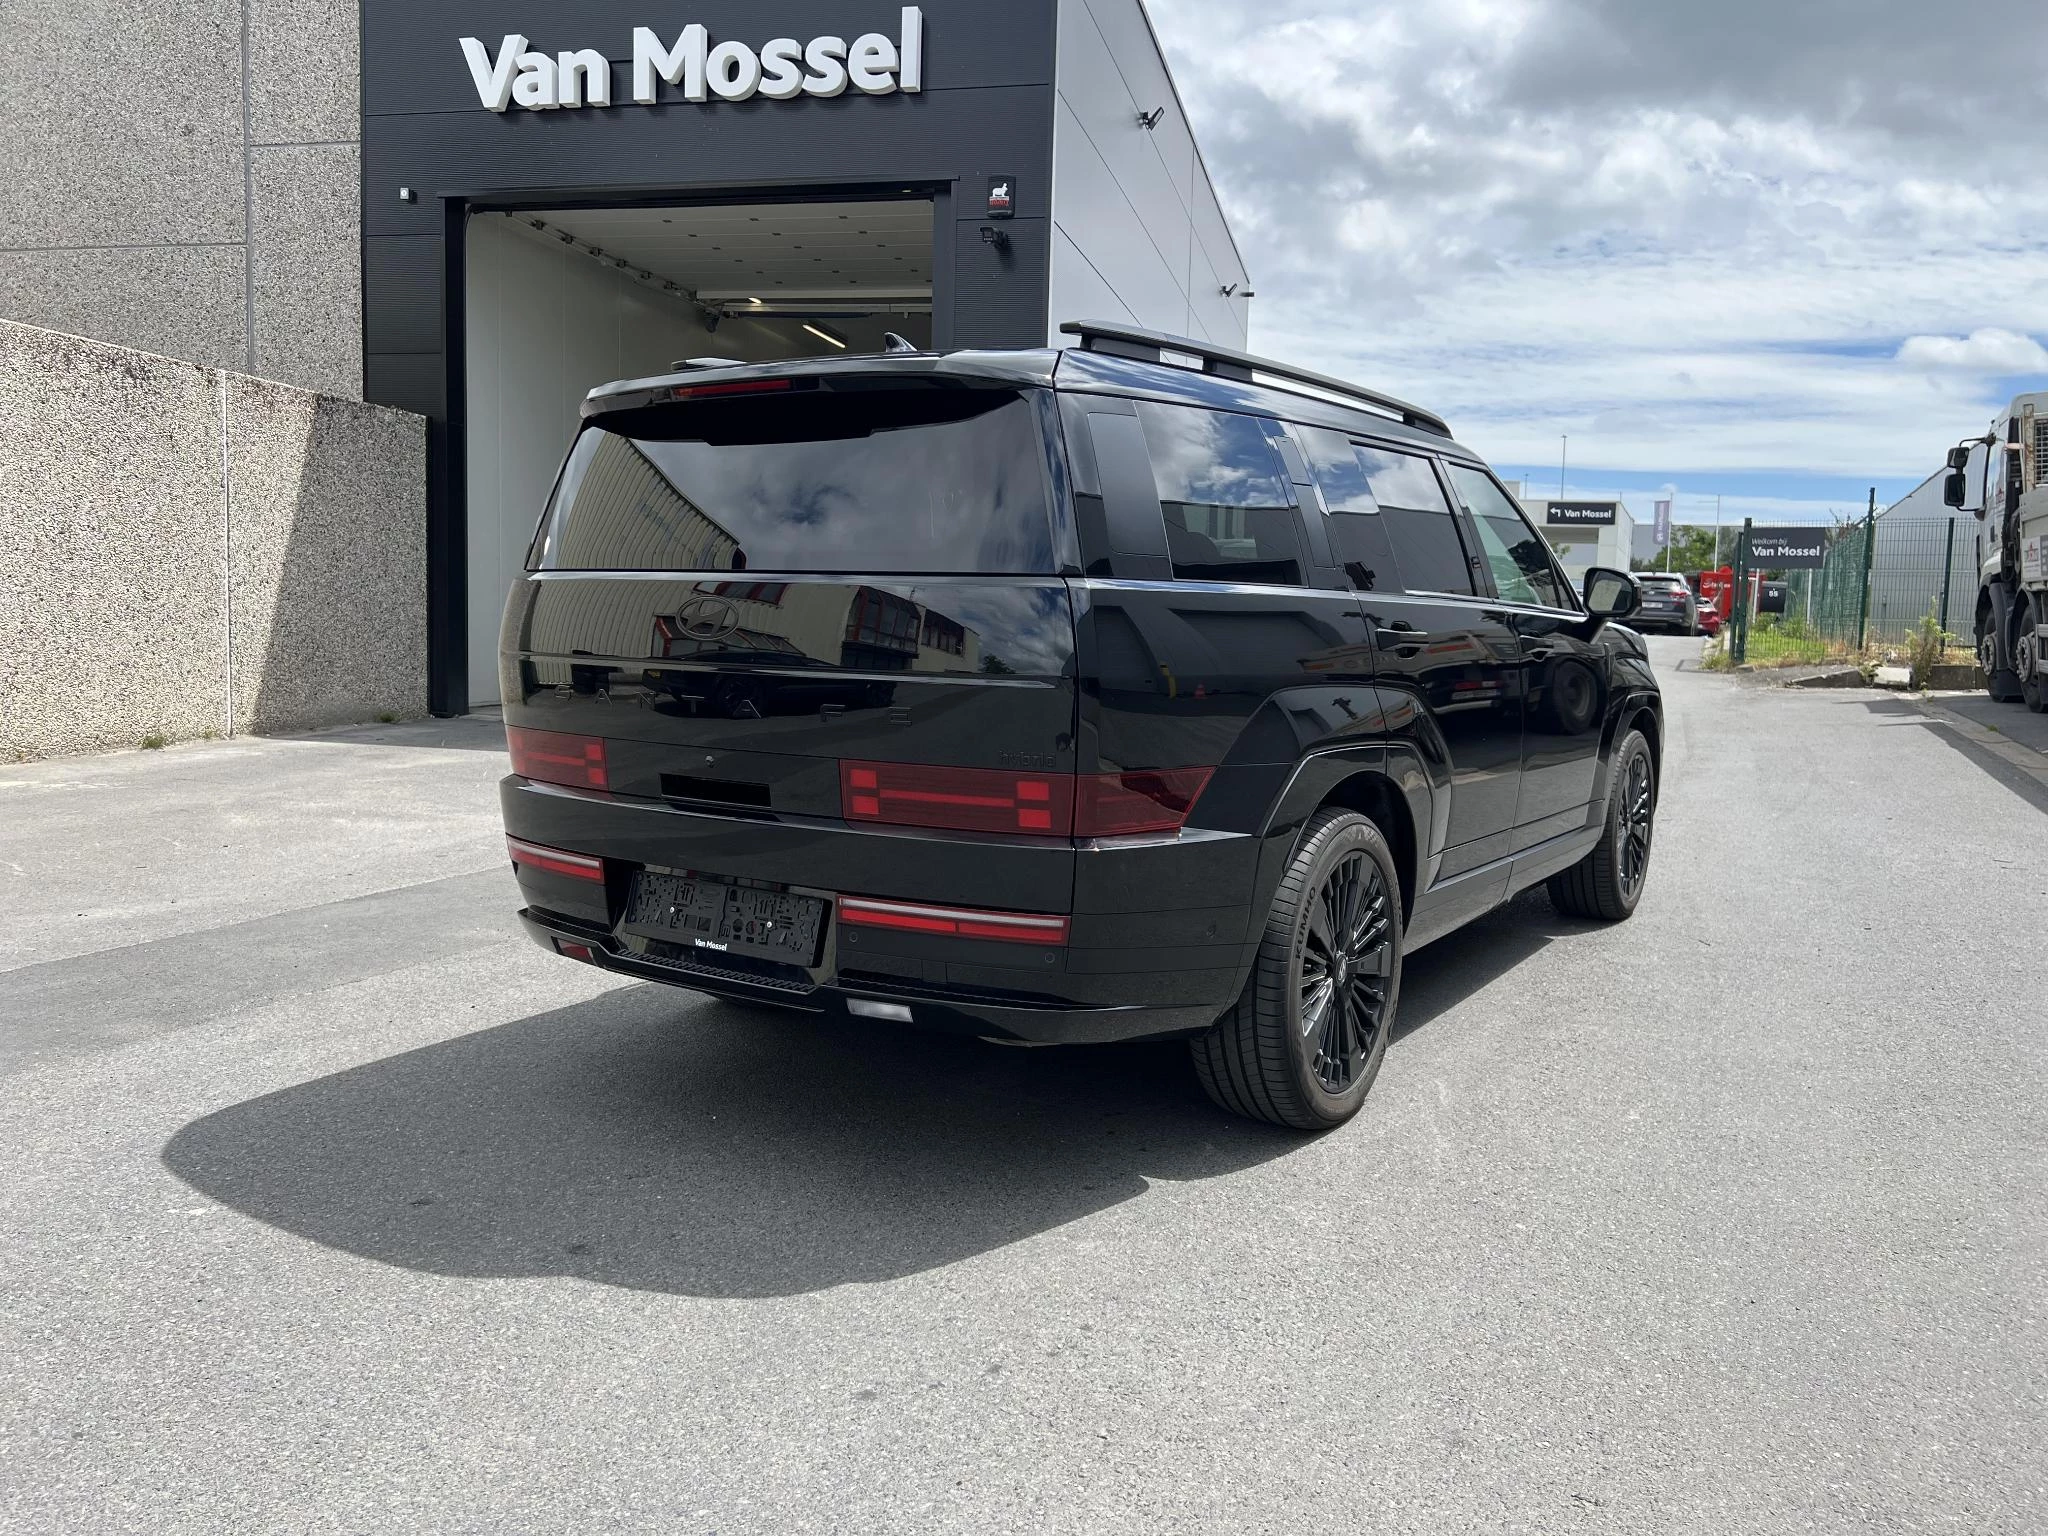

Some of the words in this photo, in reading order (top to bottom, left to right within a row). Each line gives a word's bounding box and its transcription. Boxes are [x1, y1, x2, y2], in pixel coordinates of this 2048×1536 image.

[459, 34, 611, 112] Van
[632, 5, 922, 104] Mossel
[1564, 509, 1580, 518] Van
[1582, 509, 1612, 518] Mossel
[1752, 546, 1774, 556] Van
[1778, 546, 1820, 556] Mossel
[554, 683, 763, 719] SANTA
[820, 702, 912, 727] FE
[1295, 886, 1316, 959] KUMHO
[695, 938, 706, 947] Van
[706, 940, 727, 951] Mossel
